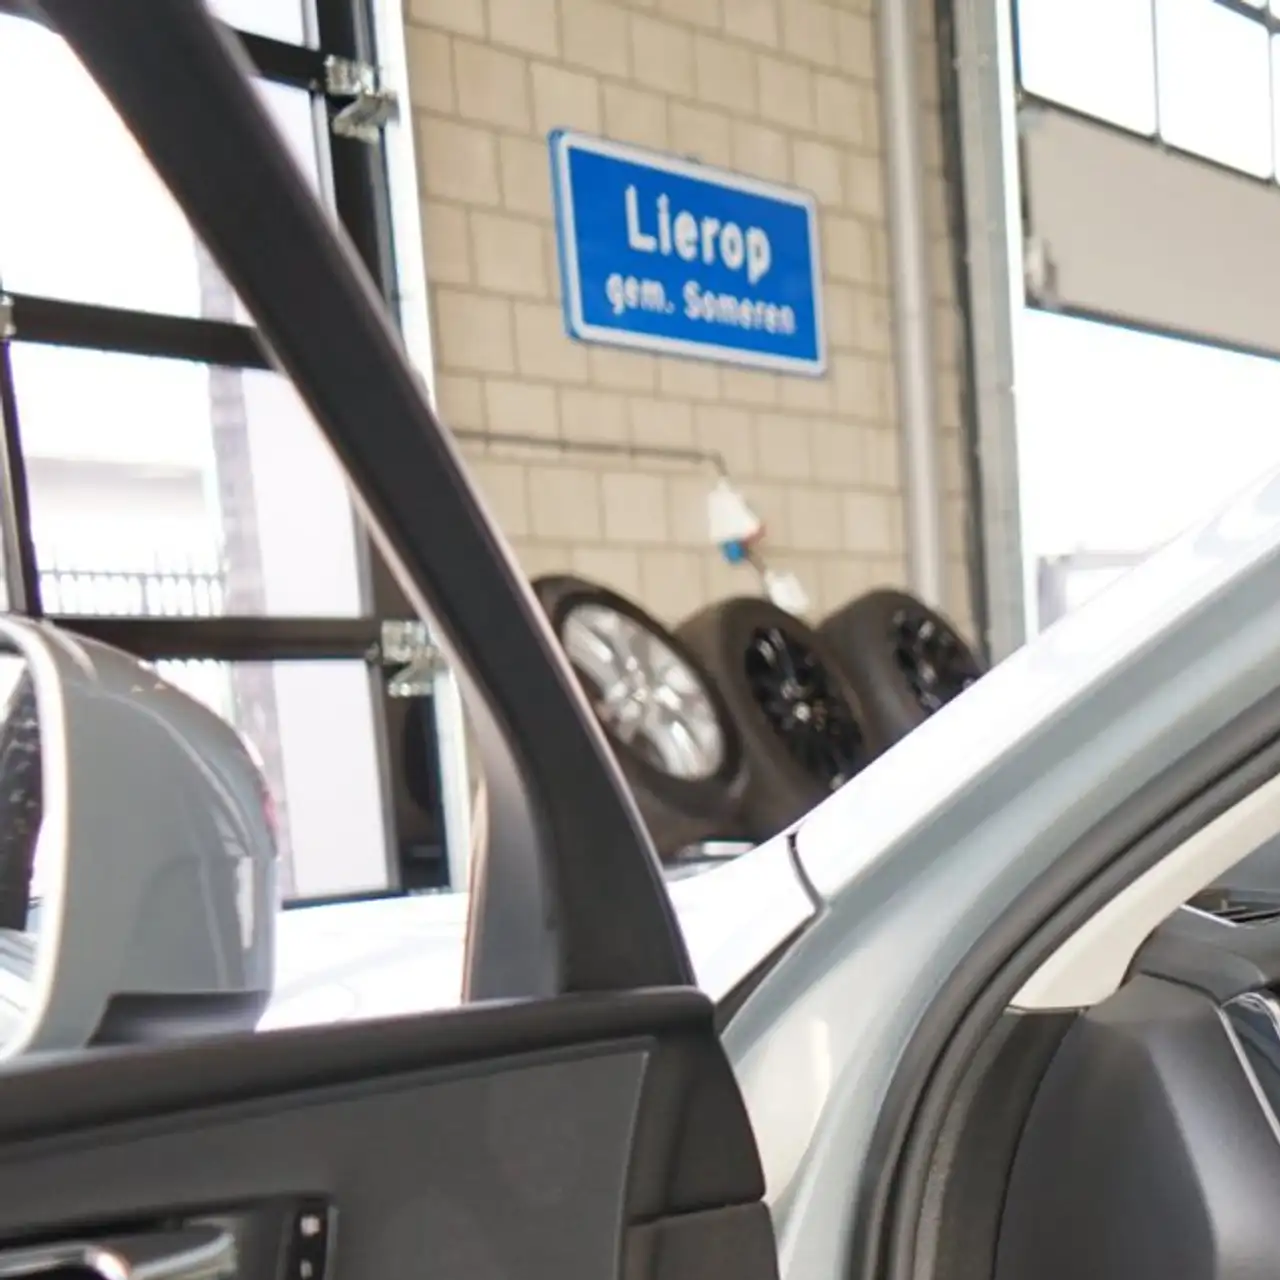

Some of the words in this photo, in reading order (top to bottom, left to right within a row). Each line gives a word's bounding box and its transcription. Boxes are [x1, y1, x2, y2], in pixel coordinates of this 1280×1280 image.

[625, 184, 772, 284] Lierop
[605, 272, 675, 314] gem.
[682, 280, 797, 335] Someren
